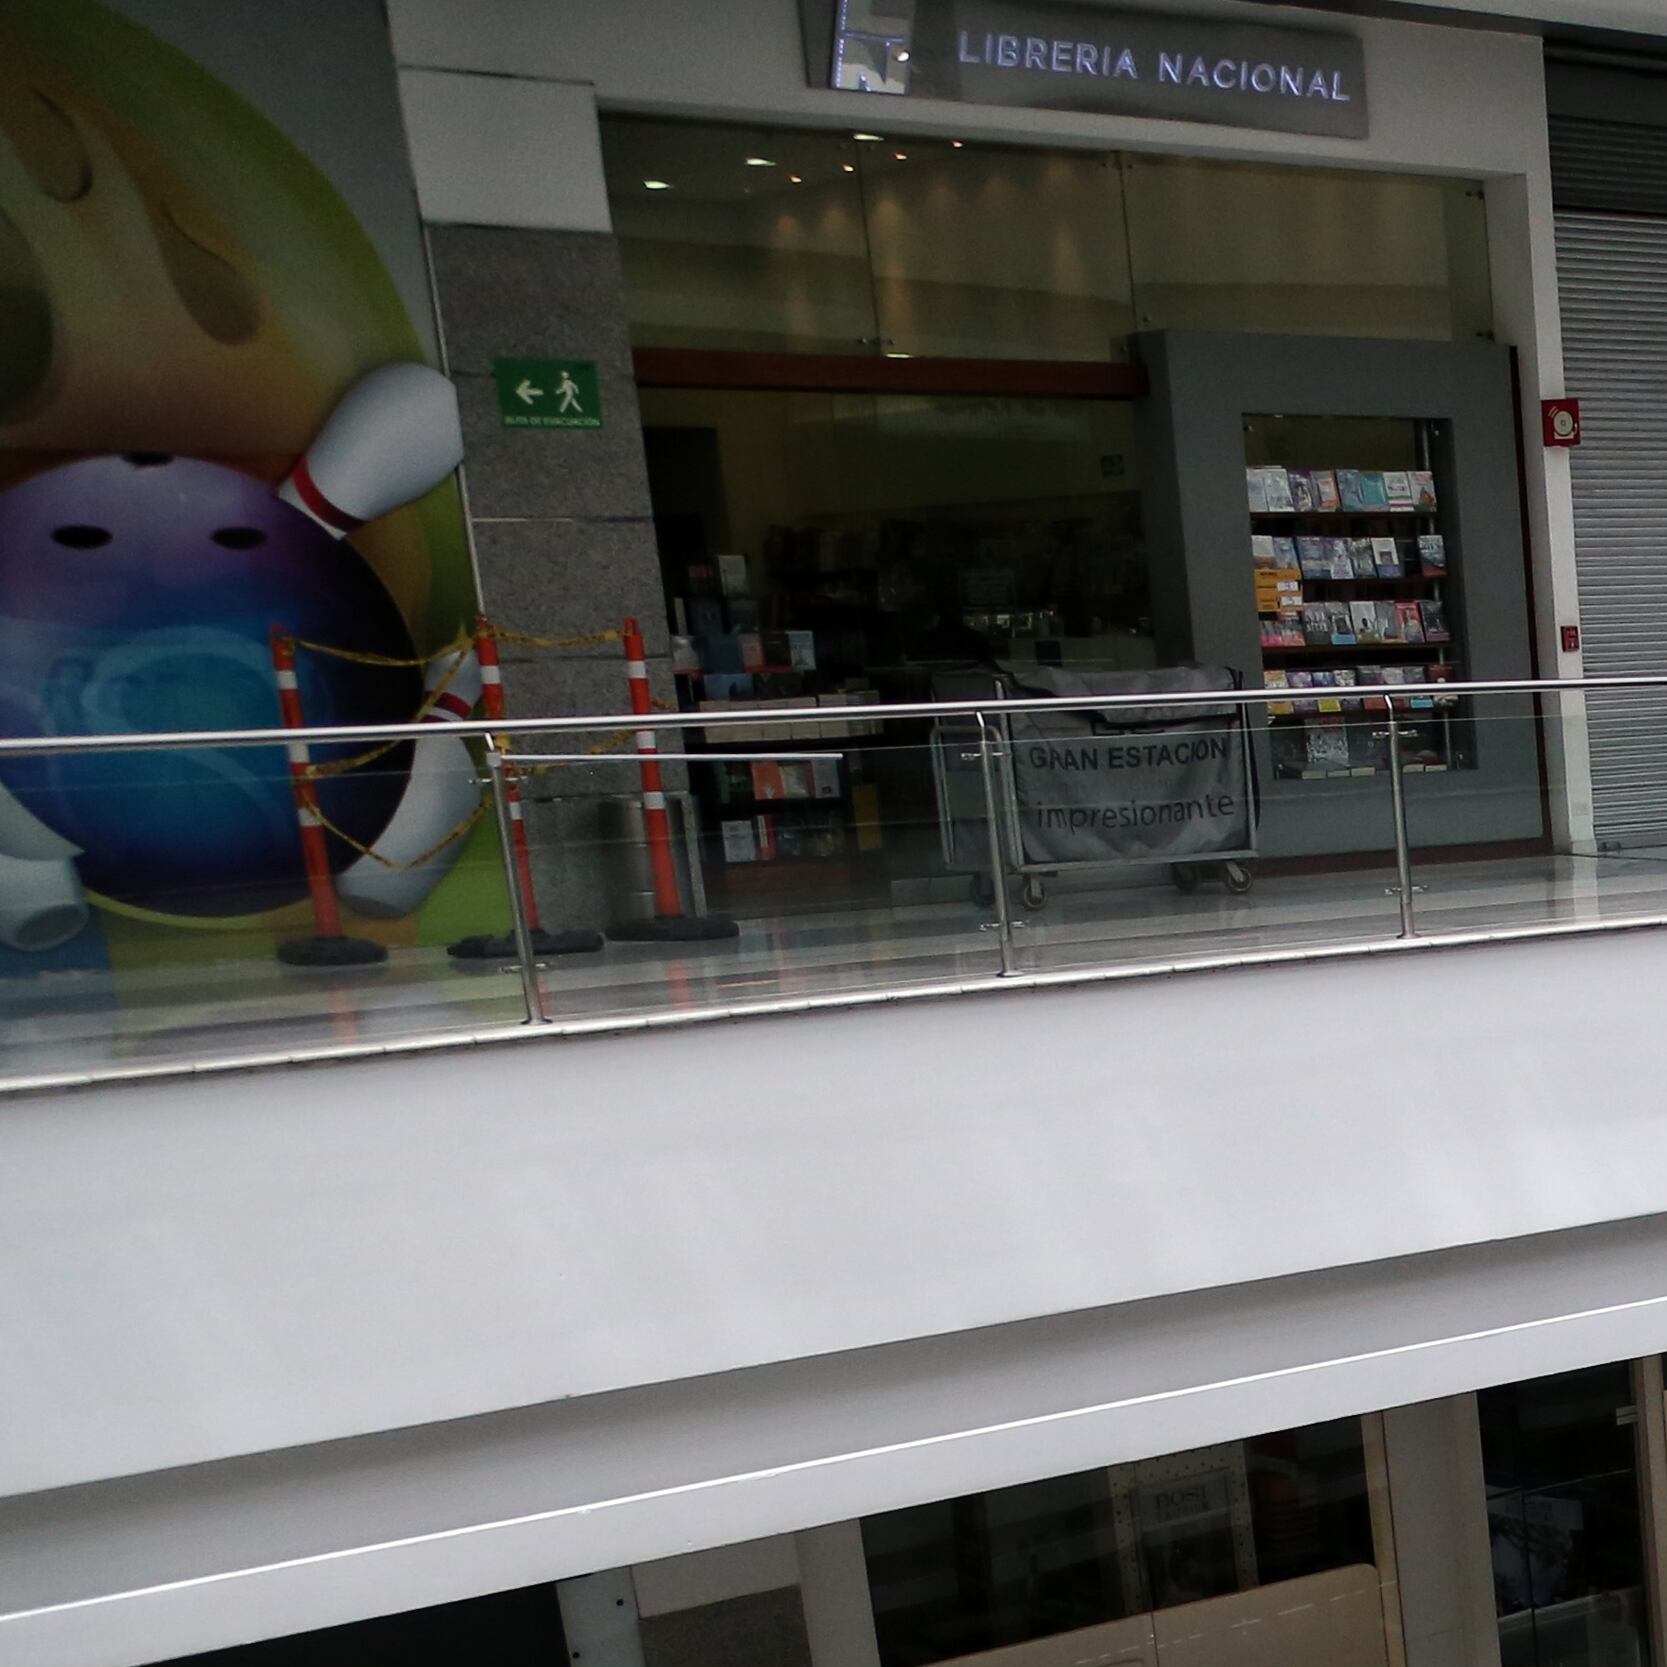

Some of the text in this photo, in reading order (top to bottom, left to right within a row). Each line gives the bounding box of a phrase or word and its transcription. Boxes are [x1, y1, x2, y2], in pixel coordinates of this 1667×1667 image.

[958, 30, 1351, 101] LIBRERIA NACIONAL
[1030, 745, 1098, 770] GRAN
[1037, 794, 1235, 835] impresionante
